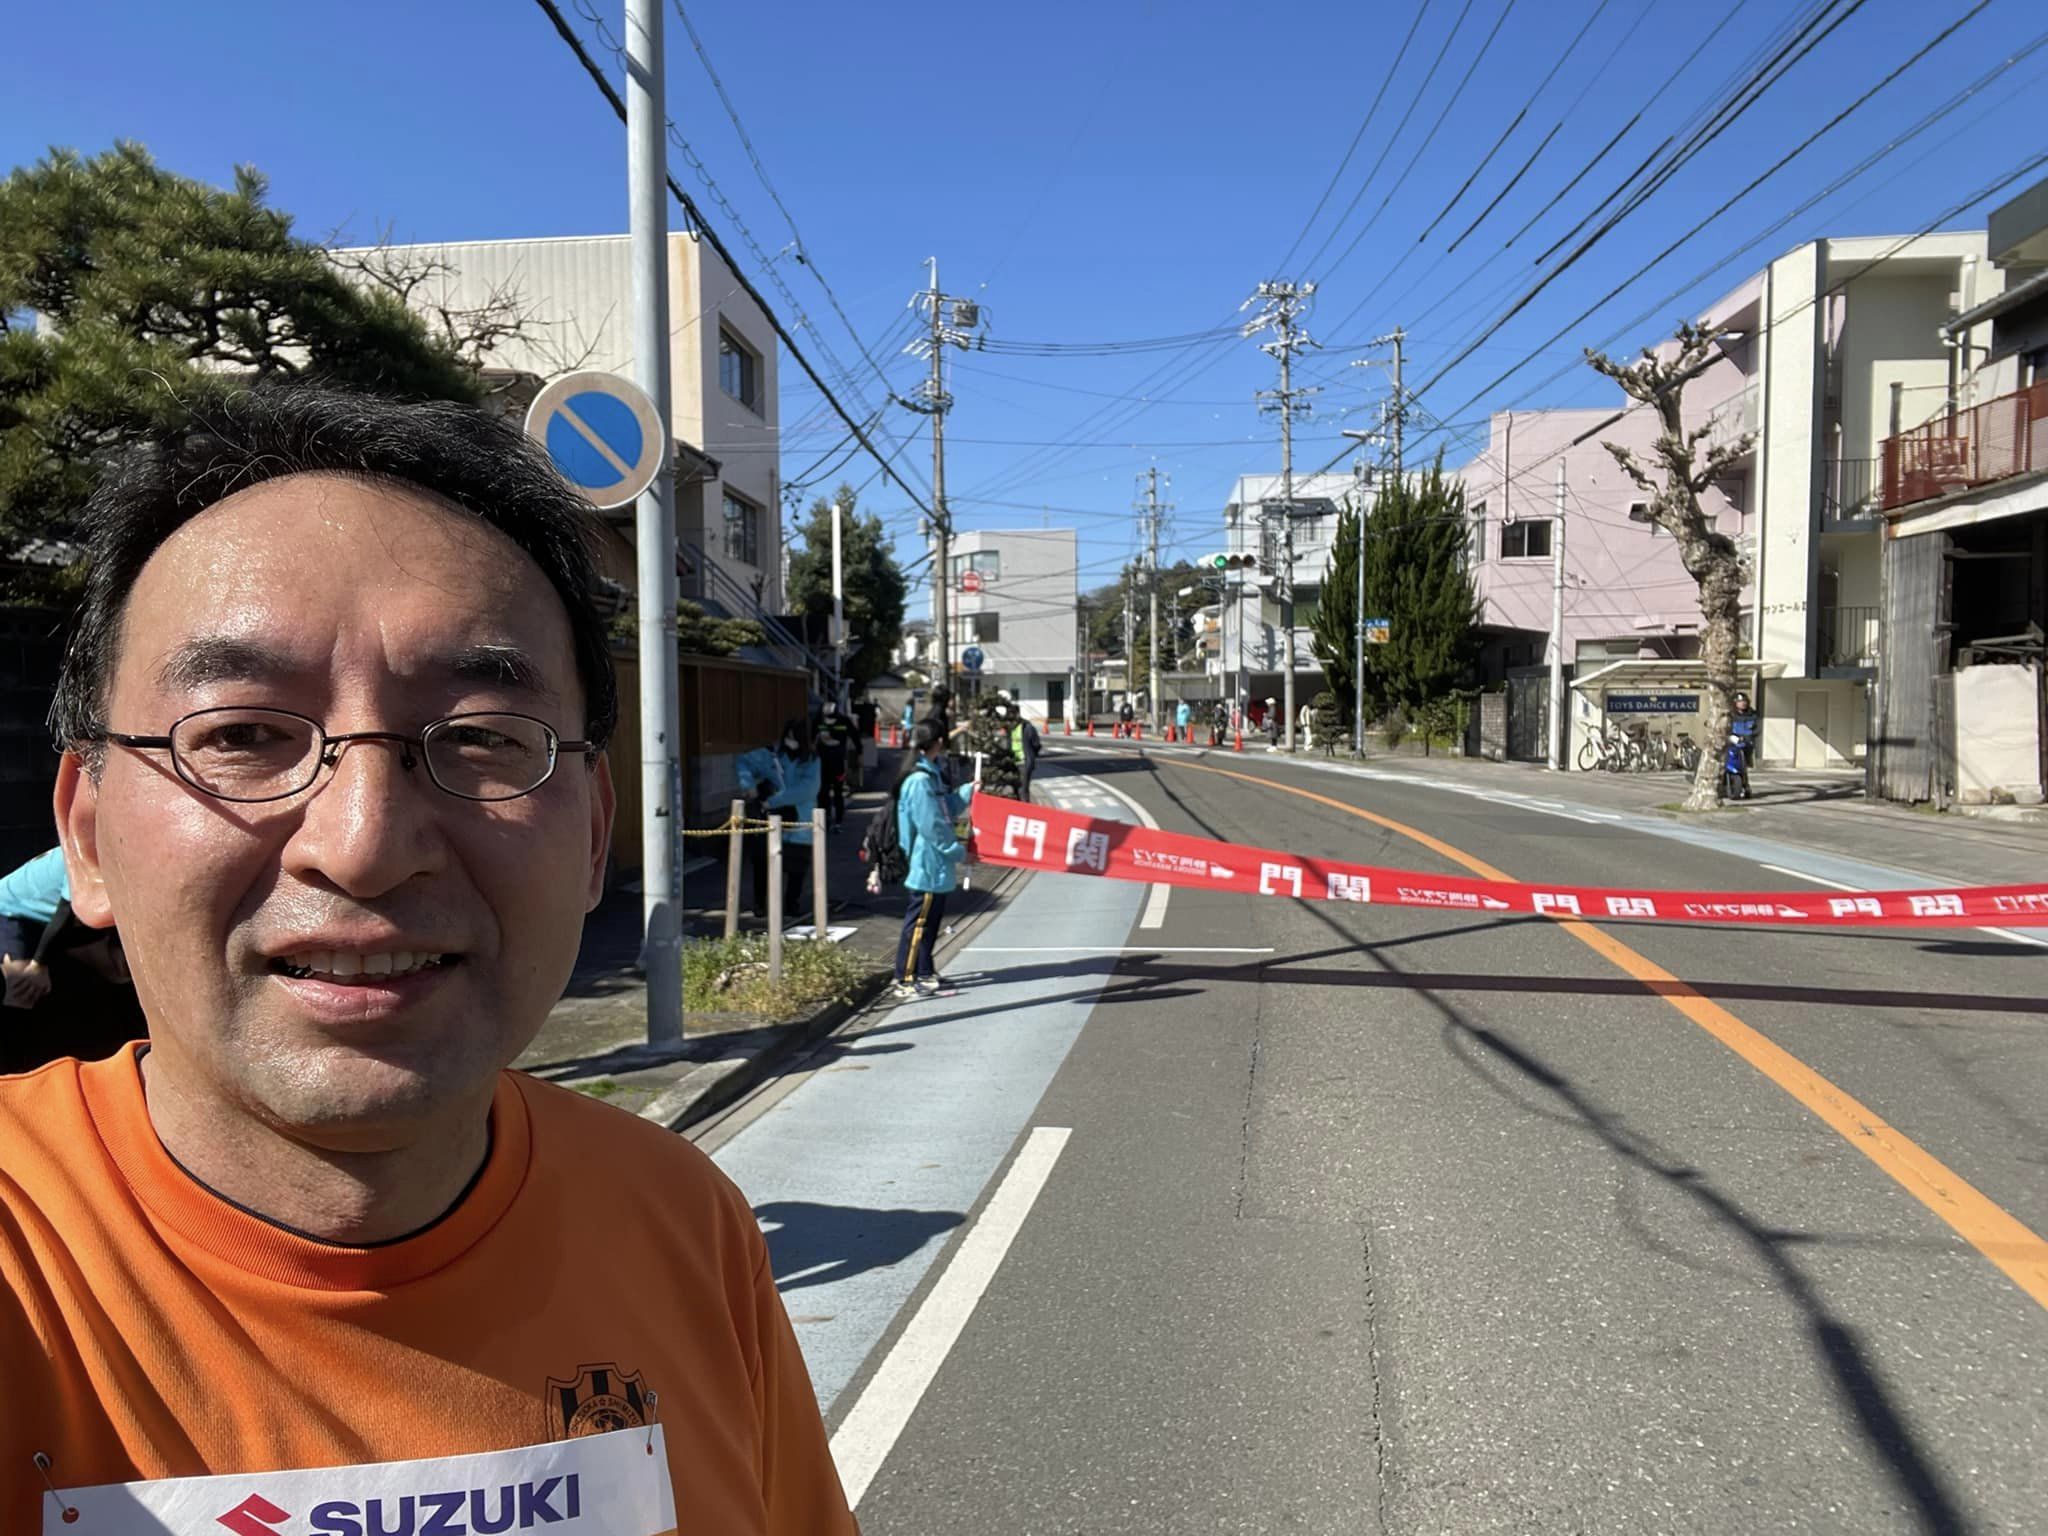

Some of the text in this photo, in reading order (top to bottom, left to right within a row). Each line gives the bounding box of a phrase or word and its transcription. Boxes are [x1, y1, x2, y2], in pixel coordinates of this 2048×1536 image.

[1635, 701, 1667, 710] DANCE
[1670, 701, 1697, 710] PLACE
[310, 1473, 581, 1536] SUZUKI
